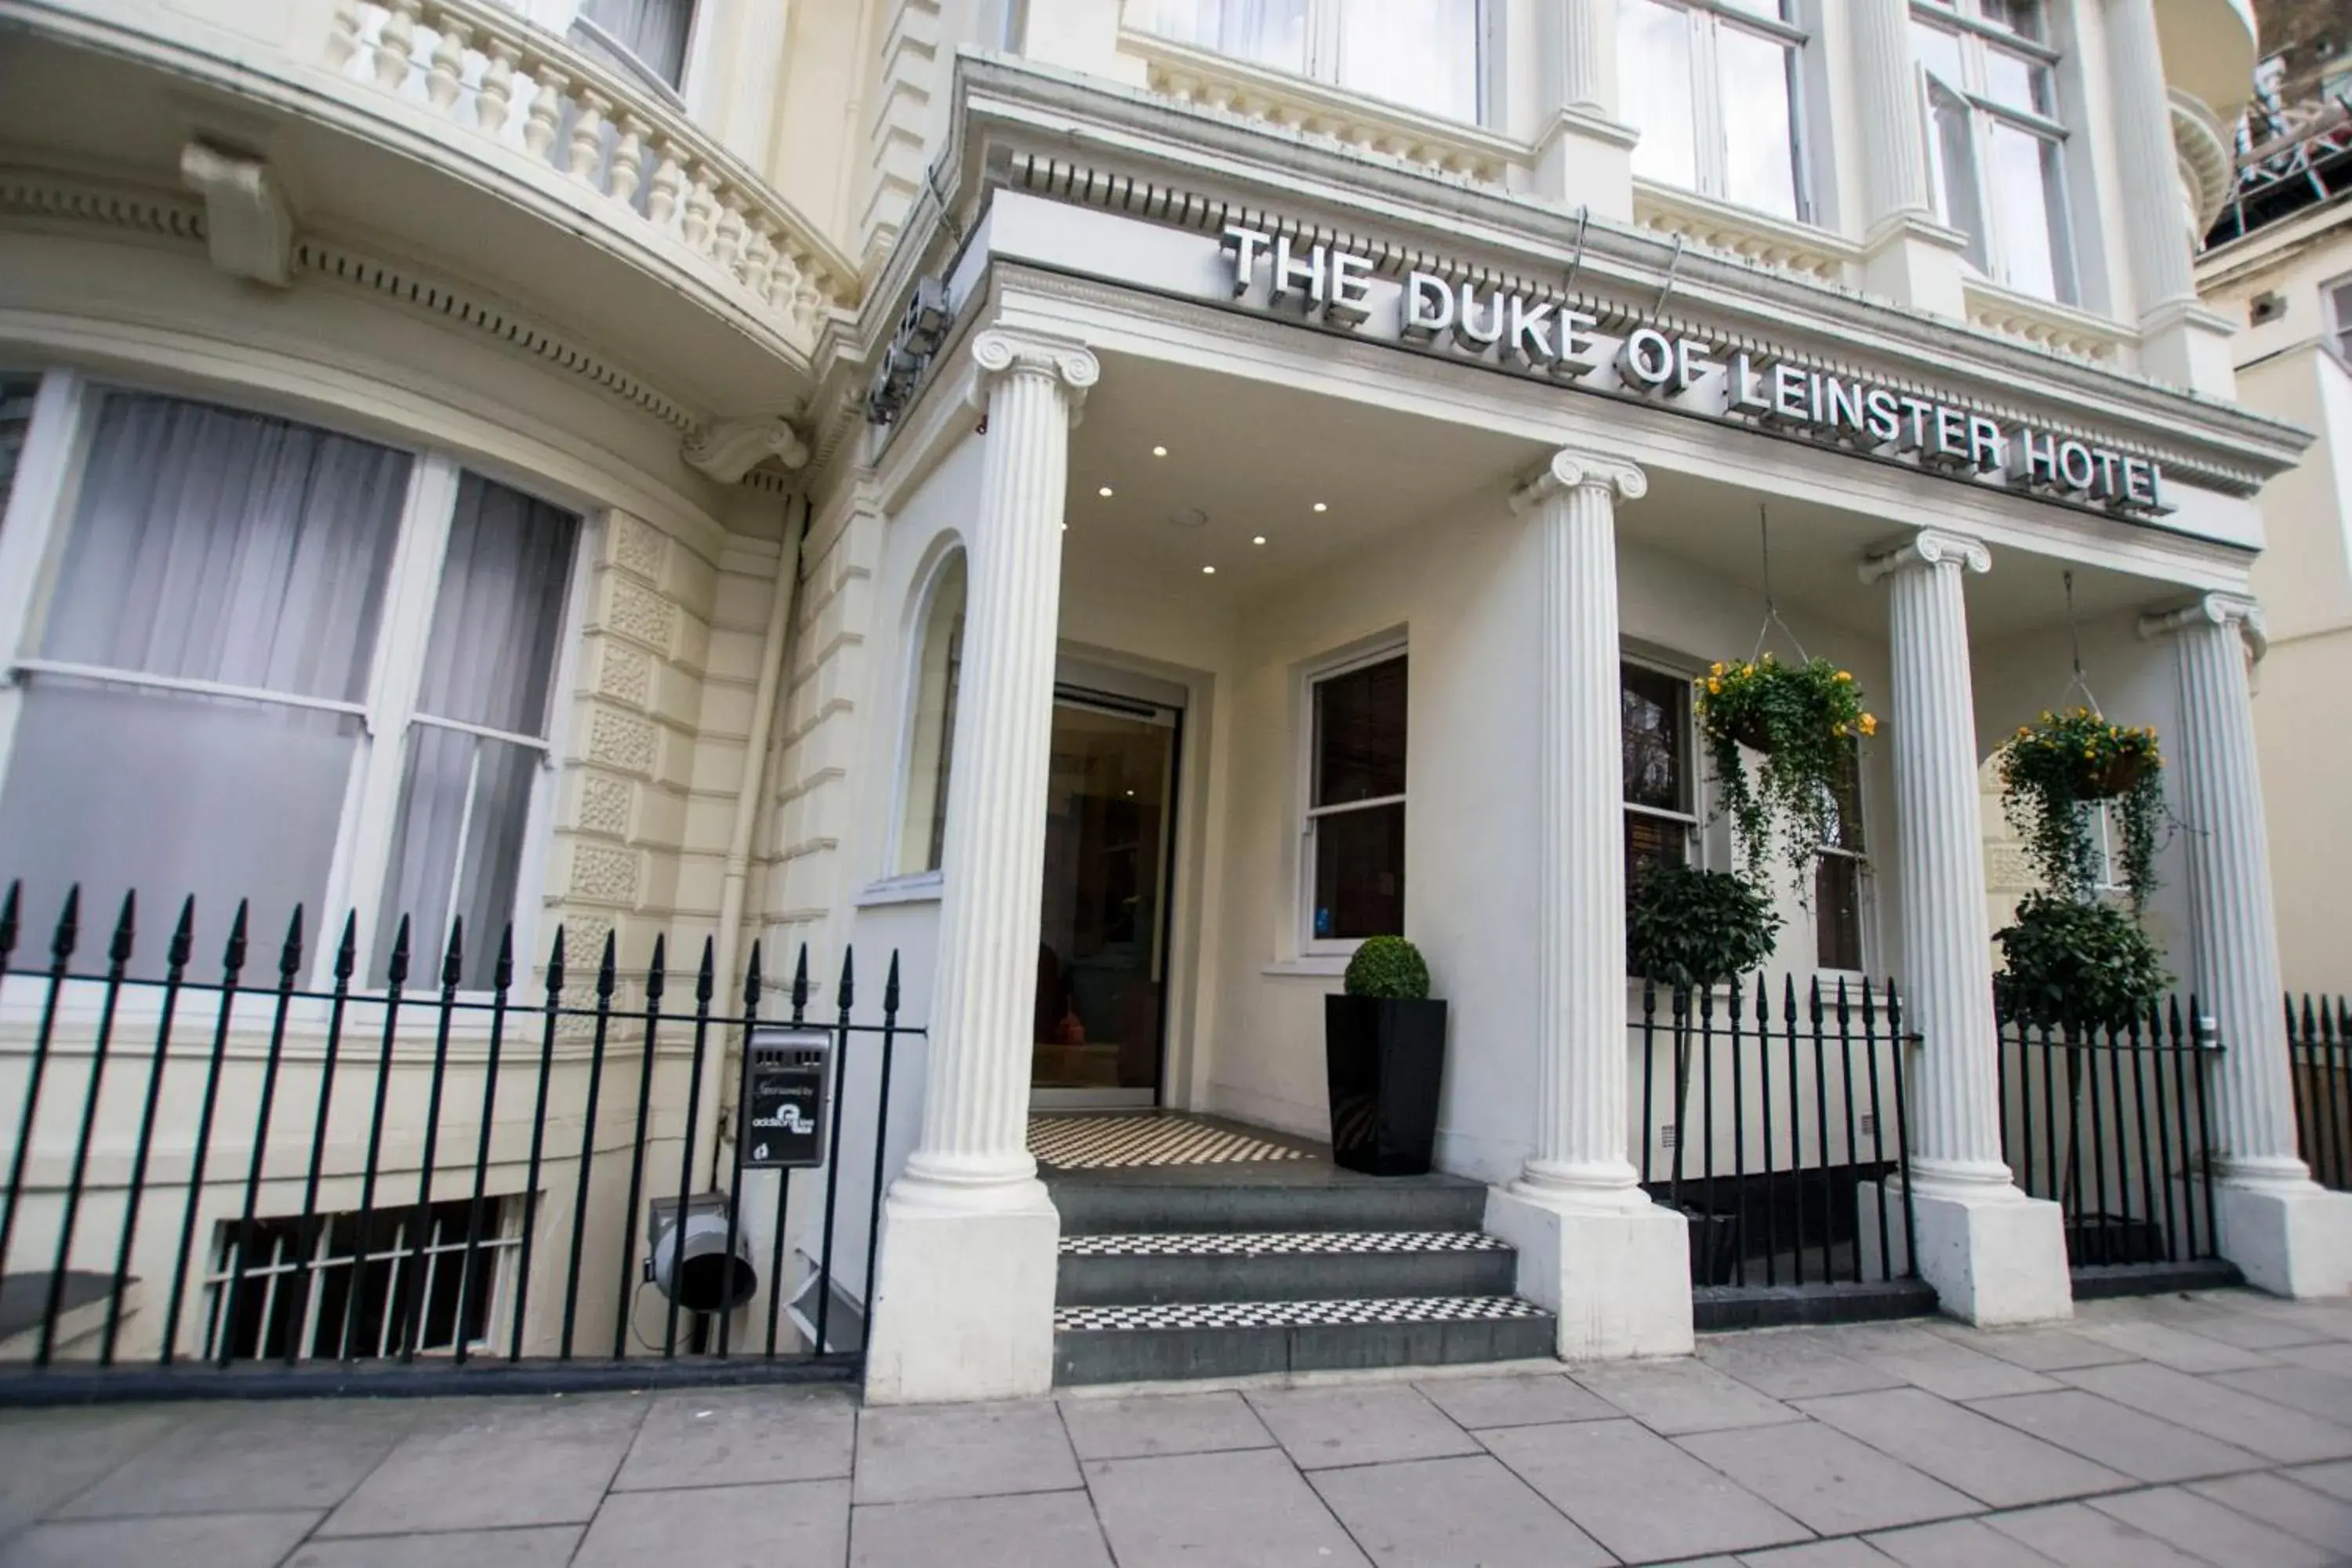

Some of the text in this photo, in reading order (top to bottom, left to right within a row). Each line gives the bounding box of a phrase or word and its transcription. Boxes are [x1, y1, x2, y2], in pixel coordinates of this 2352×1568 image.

[1221, 224, 2174, 515] THE DUKE OF LEINSTER HOTEL
